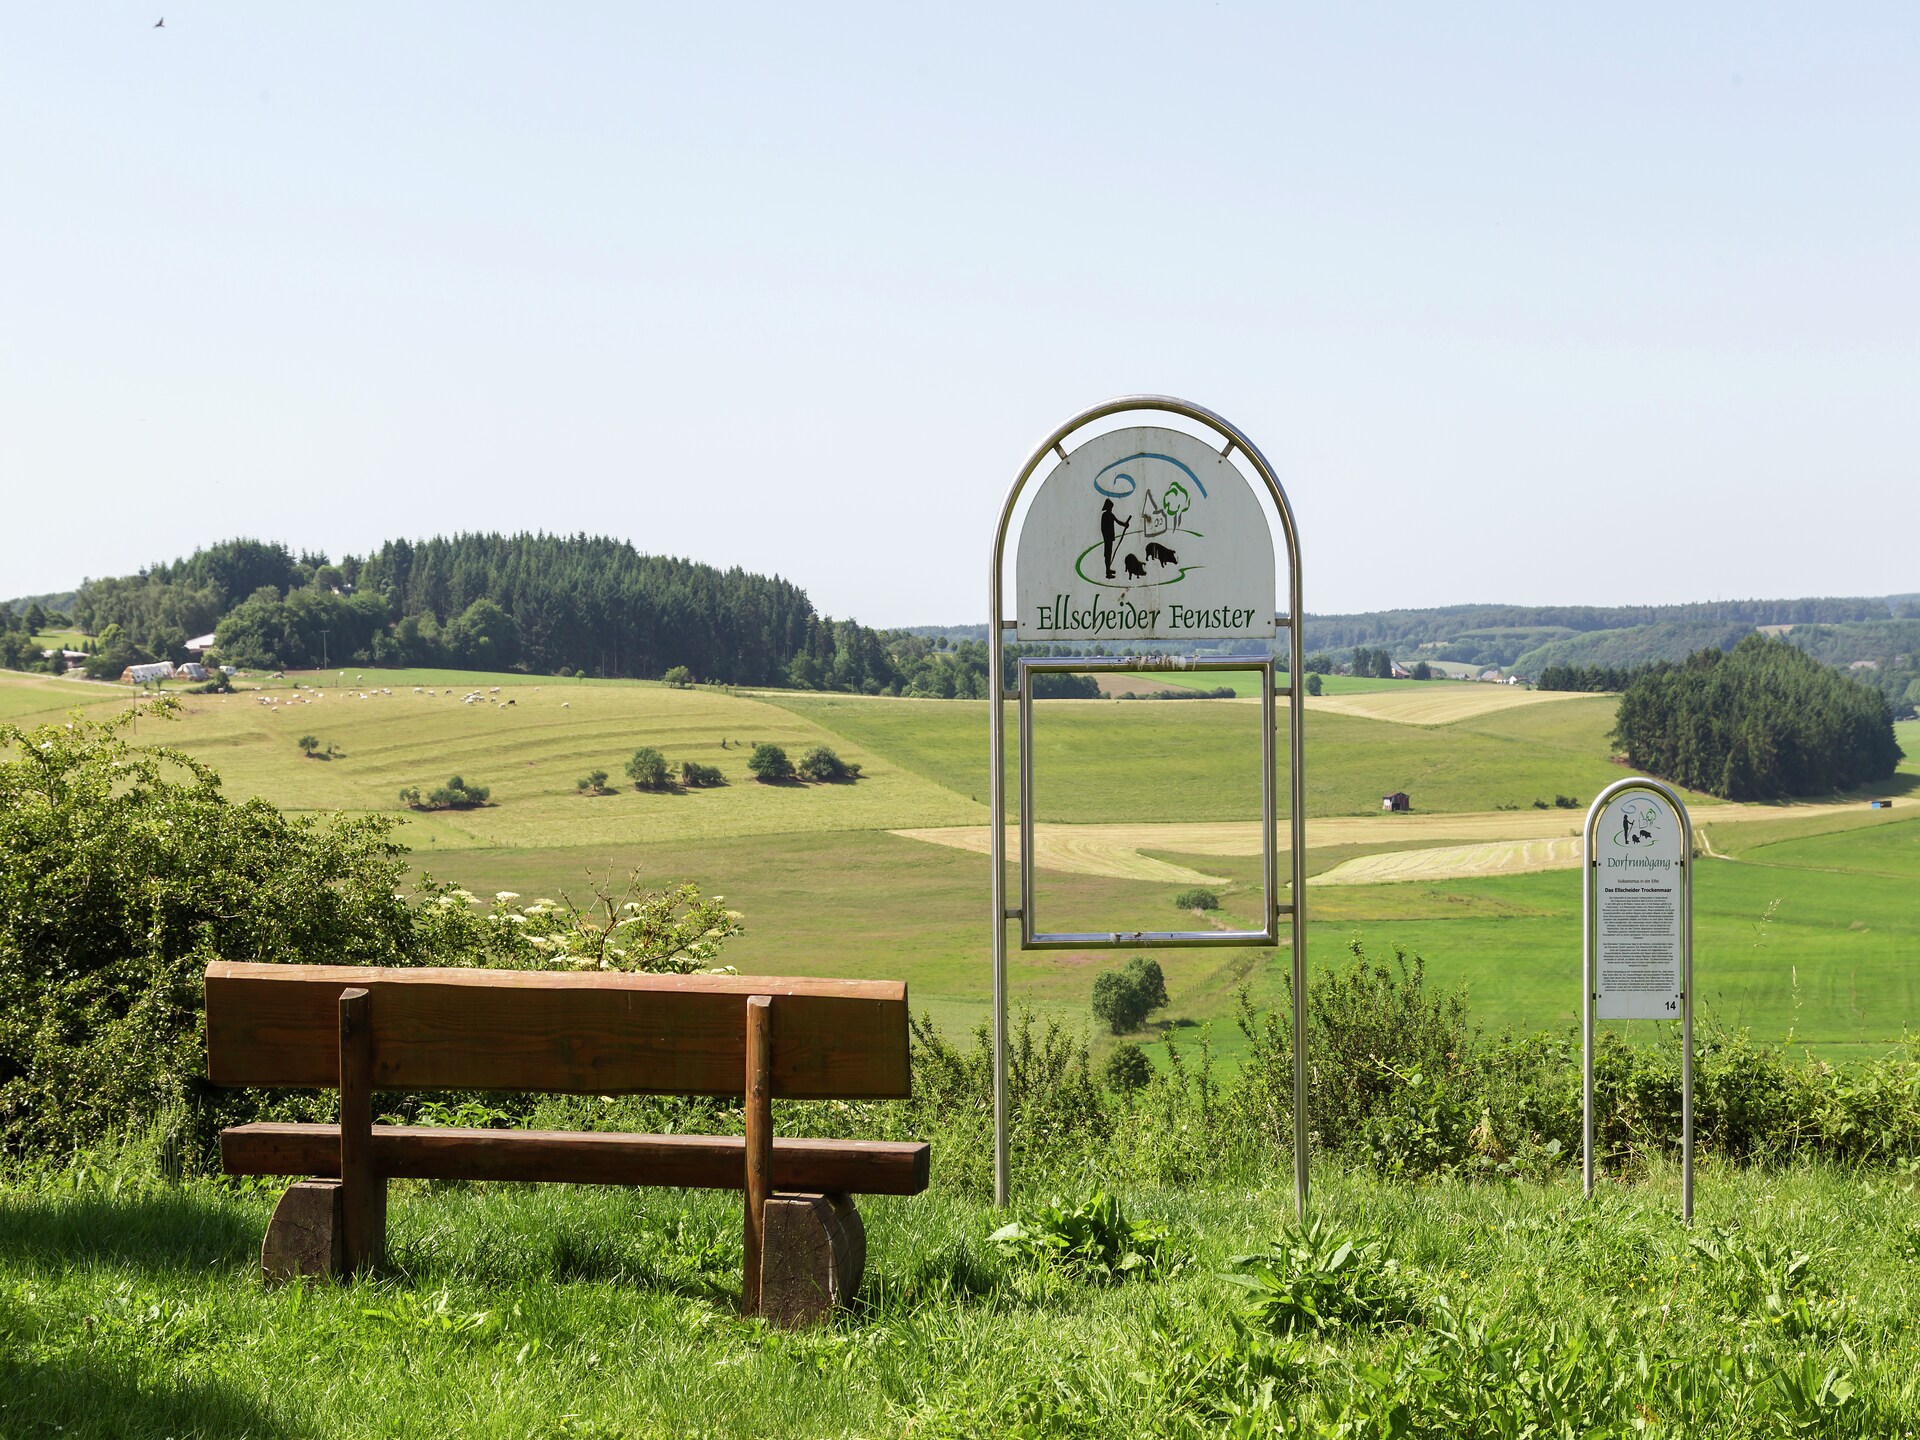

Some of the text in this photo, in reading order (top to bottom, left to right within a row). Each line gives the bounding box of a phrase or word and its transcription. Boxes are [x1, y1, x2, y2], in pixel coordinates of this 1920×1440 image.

[1036, 594, 1256, 635] Ellscheider Fenster
[1607, 853, 1671, 871] Dorfrundgang
[1664, 1001, 1676, 1011] 14
